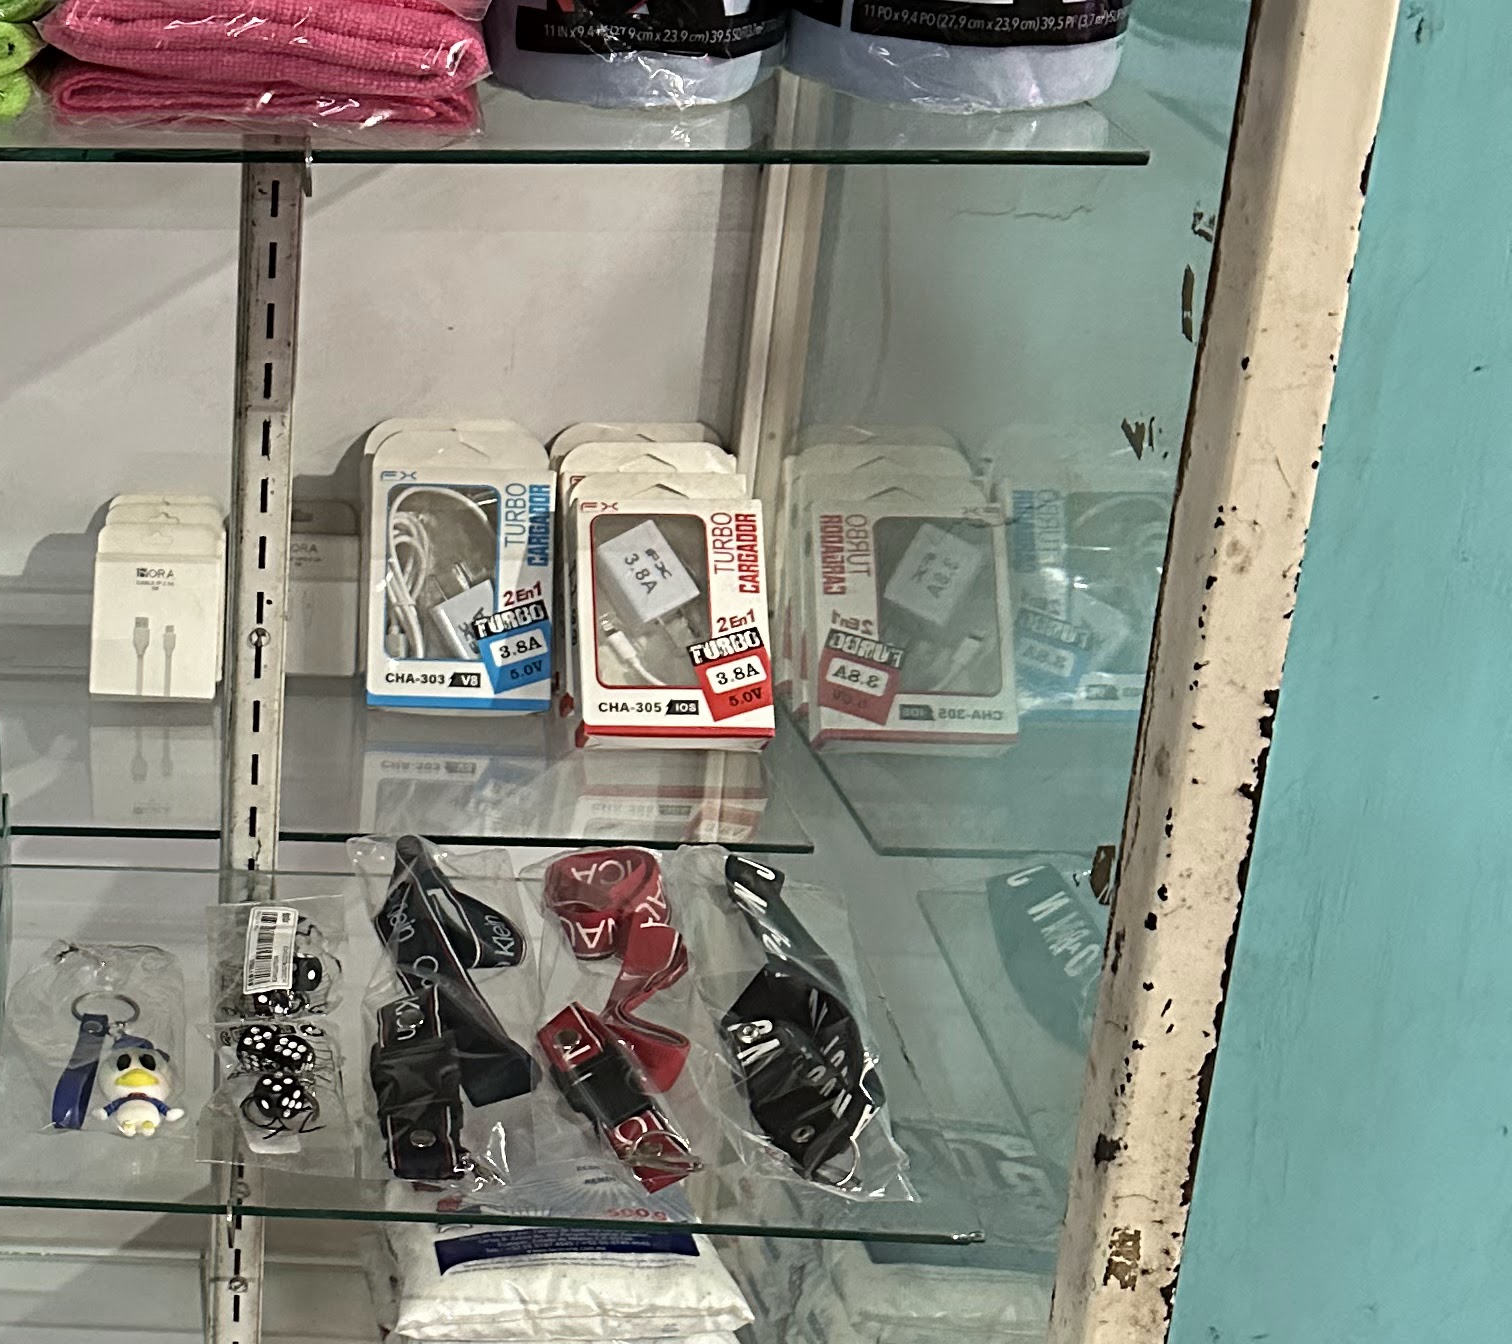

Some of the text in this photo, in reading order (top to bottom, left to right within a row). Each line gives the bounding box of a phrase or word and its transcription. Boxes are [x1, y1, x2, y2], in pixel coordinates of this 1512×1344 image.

[504, 482, 527, 548] TURBO
[527, 483, 551, 567] CARGADOR
[711, 512, 733, 574] TURBO
[735, 513, 760, 595] CARGADOR
[624, 552, 658, 596] 3.8A
[498, 635, 544, 660] 3.8A
[384, 671, 478, 686] CHA-303 V8
[509, 660, 544, 680] 5.0V
[715, 663, 760, 686] 3.8A
[598, 700, 698, 713] CHA-305 IOS
[728, 687, 763, 707] 5.0V
